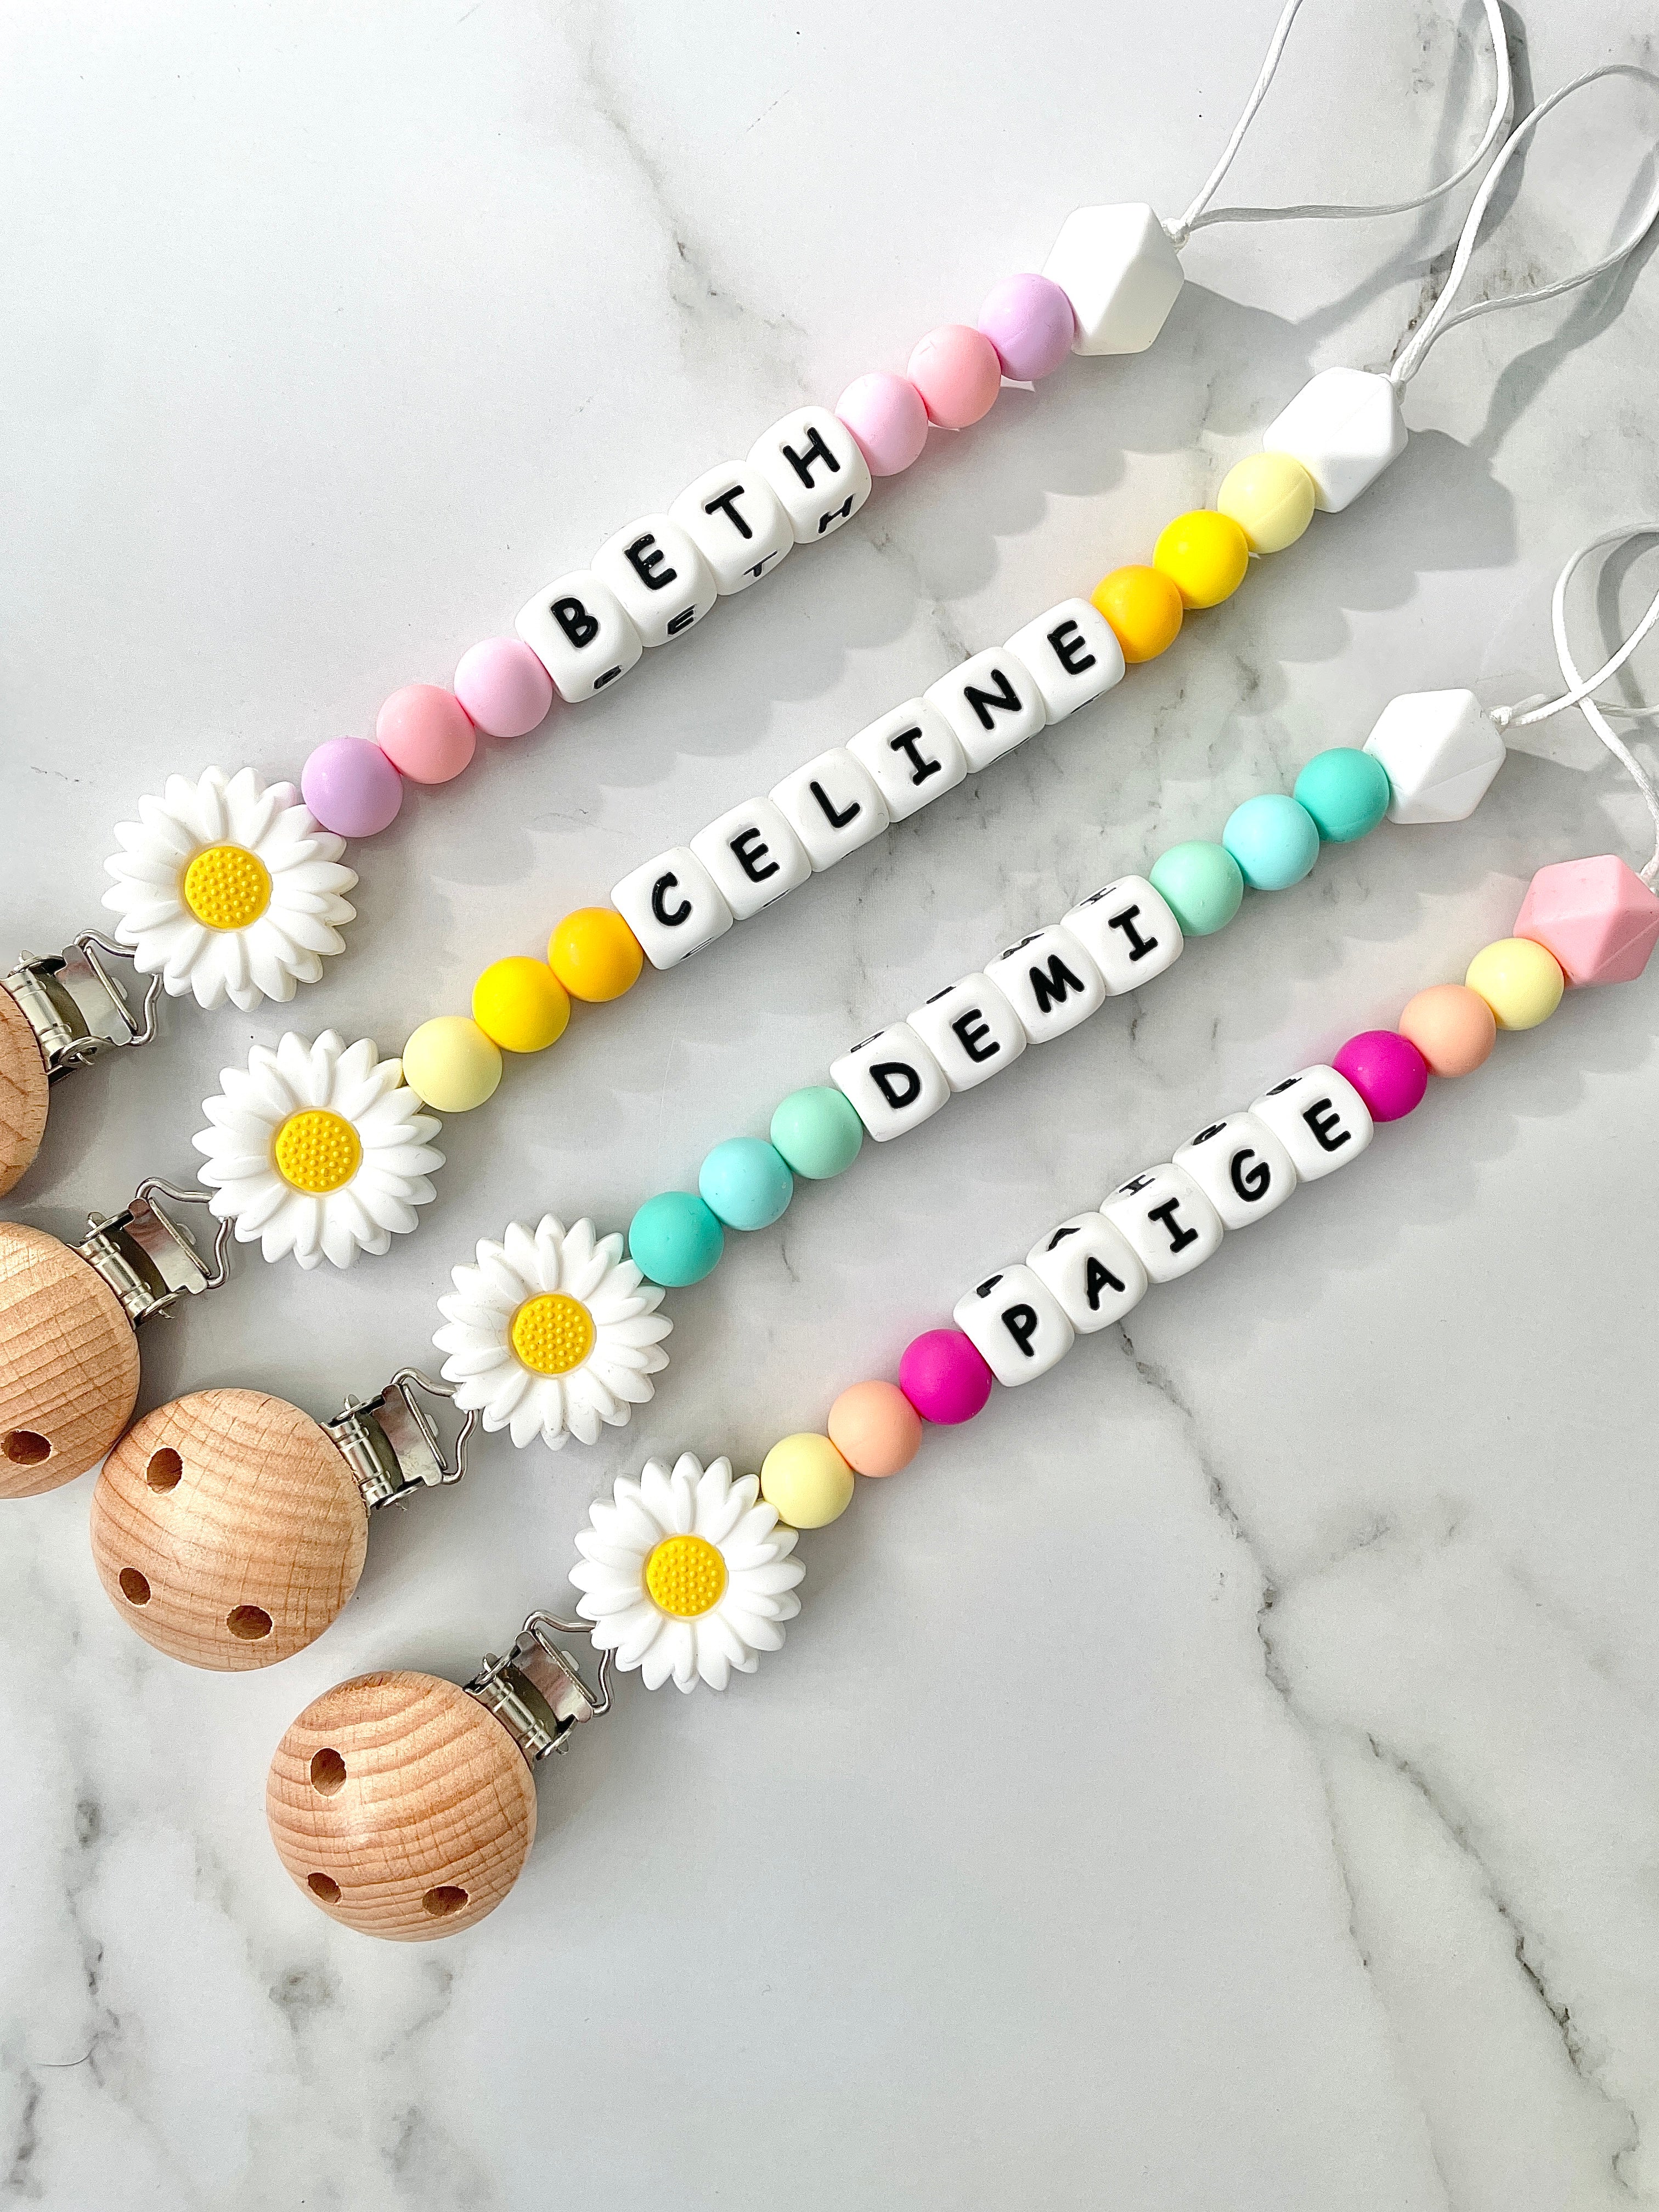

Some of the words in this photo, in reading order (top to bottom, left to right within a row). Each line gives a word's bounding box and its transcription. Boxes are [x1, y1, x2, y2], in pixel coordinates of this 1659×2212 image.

[550, 426, 841, 649] BETH
[651, 619, 1096, 927] CELINE
[869, 904, 1158, 1109] DEMI
[1001, 1098, 1351, 1357] PAIGE
